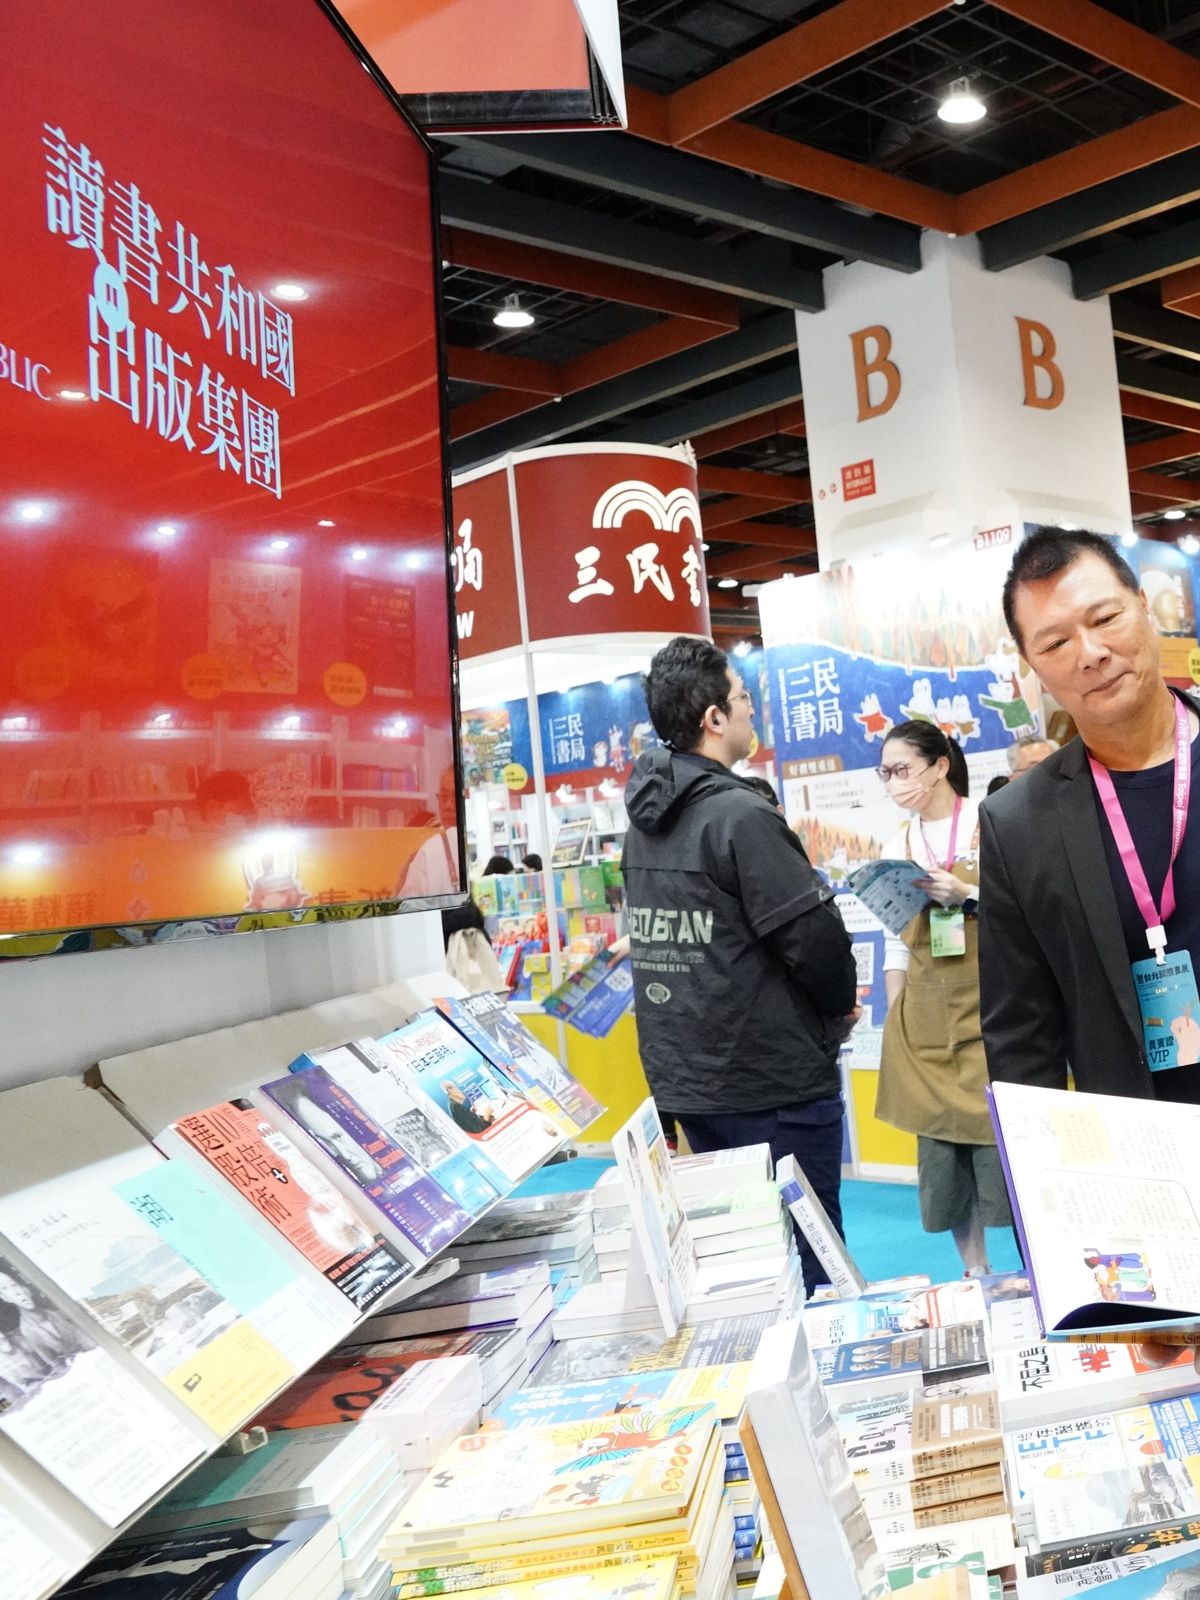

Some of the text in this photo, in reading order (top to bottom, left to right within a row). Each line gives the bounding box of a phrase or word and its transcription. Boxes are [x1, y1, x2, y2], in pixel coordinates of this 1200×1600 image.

[42, 122, 296, 397] 讀書共和國
[88, 293, 282, 499] 出版集團
[848, 325, 902, 423] B
[1014, 316, 1065, 410] B
[1176, 782, 1187, 809] Taipei
[1149, 1049, 1170, 1064] VIP
[182, 1115, 294, 1226] 選股術
[1019, 1346, 1053, 1392] 不屈之島
[1018, 1429, 1113, 1453] ETF
